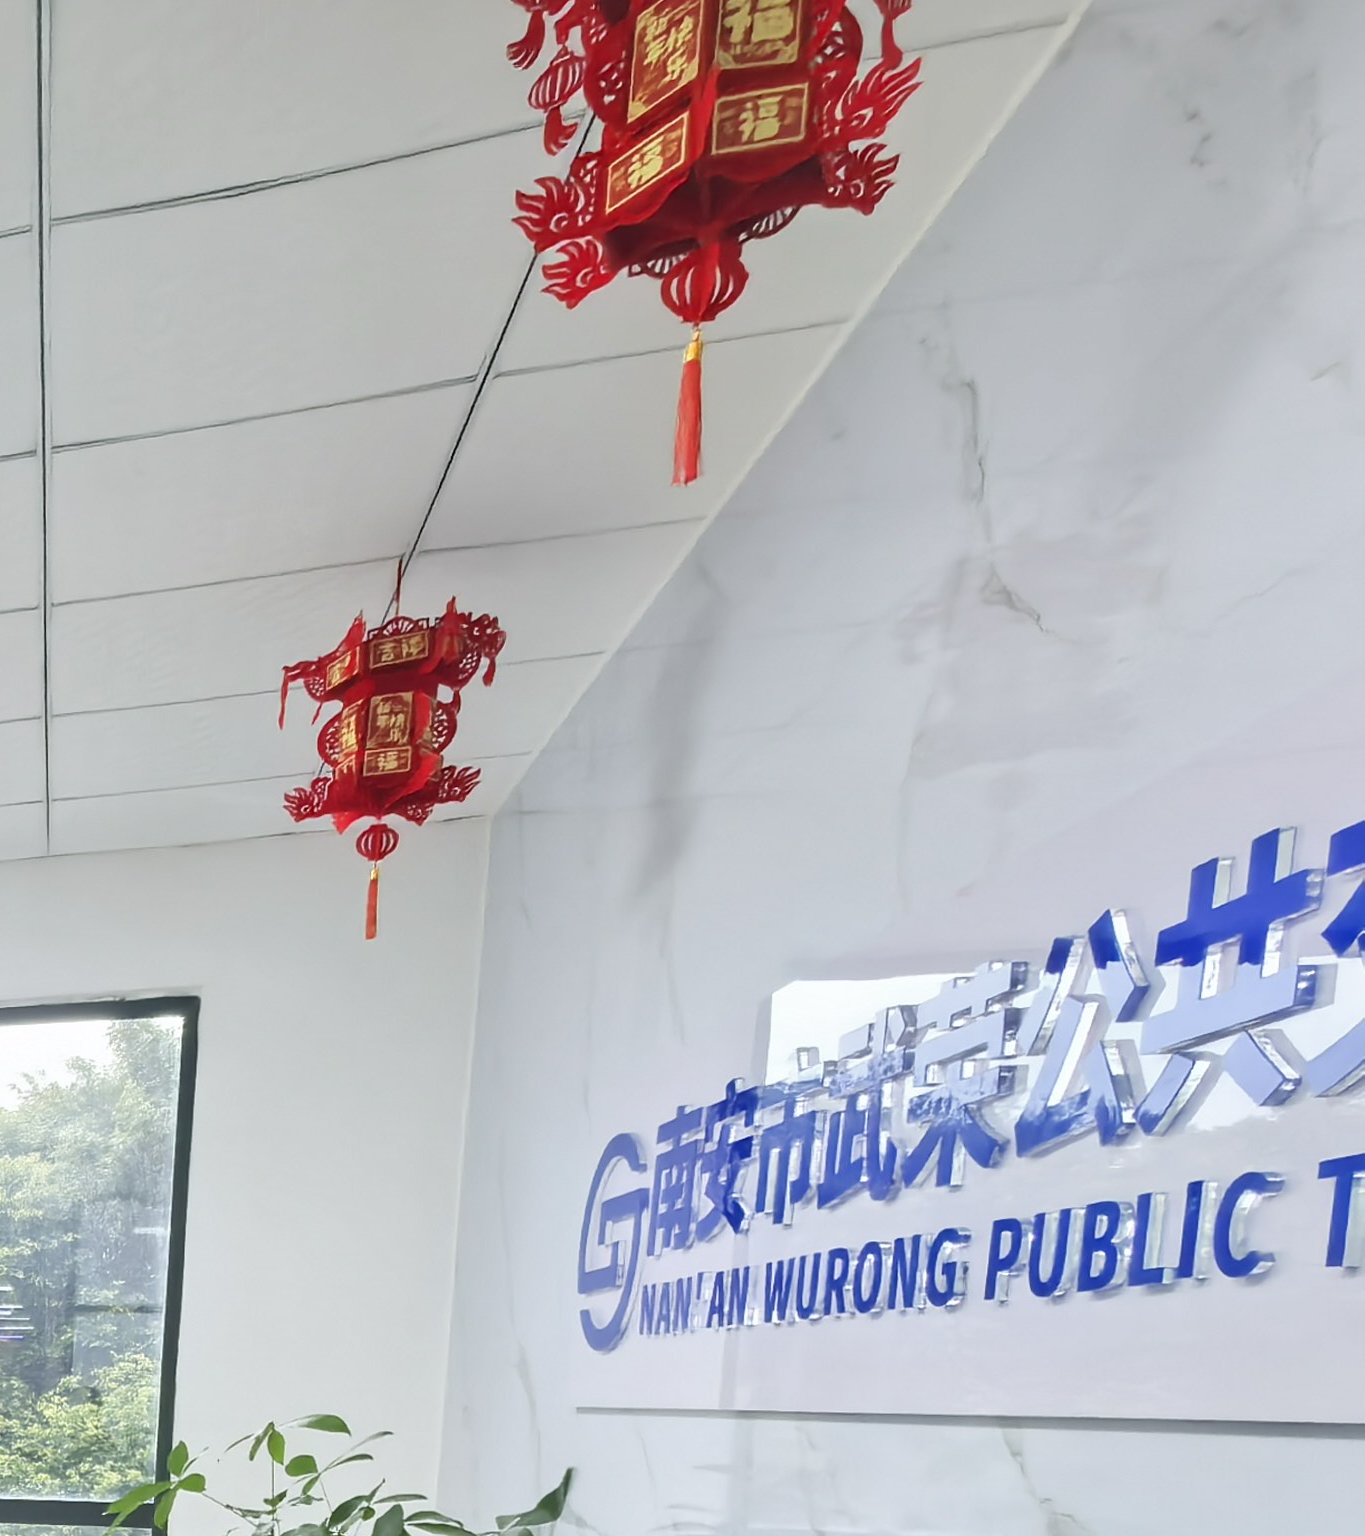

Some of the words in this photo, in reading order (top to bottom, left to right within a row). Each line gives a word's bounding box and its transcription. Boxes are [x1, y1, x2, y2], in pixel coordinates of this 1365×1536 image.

[723, 0, 795, 43] 福
[738, 95, 784, 143] 福
[627, 135, 664, 189] 福
[377, 752, 399, 772] 福
[639, 1266, 753, 1337] NAN'AN
[763, 1227, 971, 1324] WURONG
[983, 1170, 1283, 1304] PUBLIC
